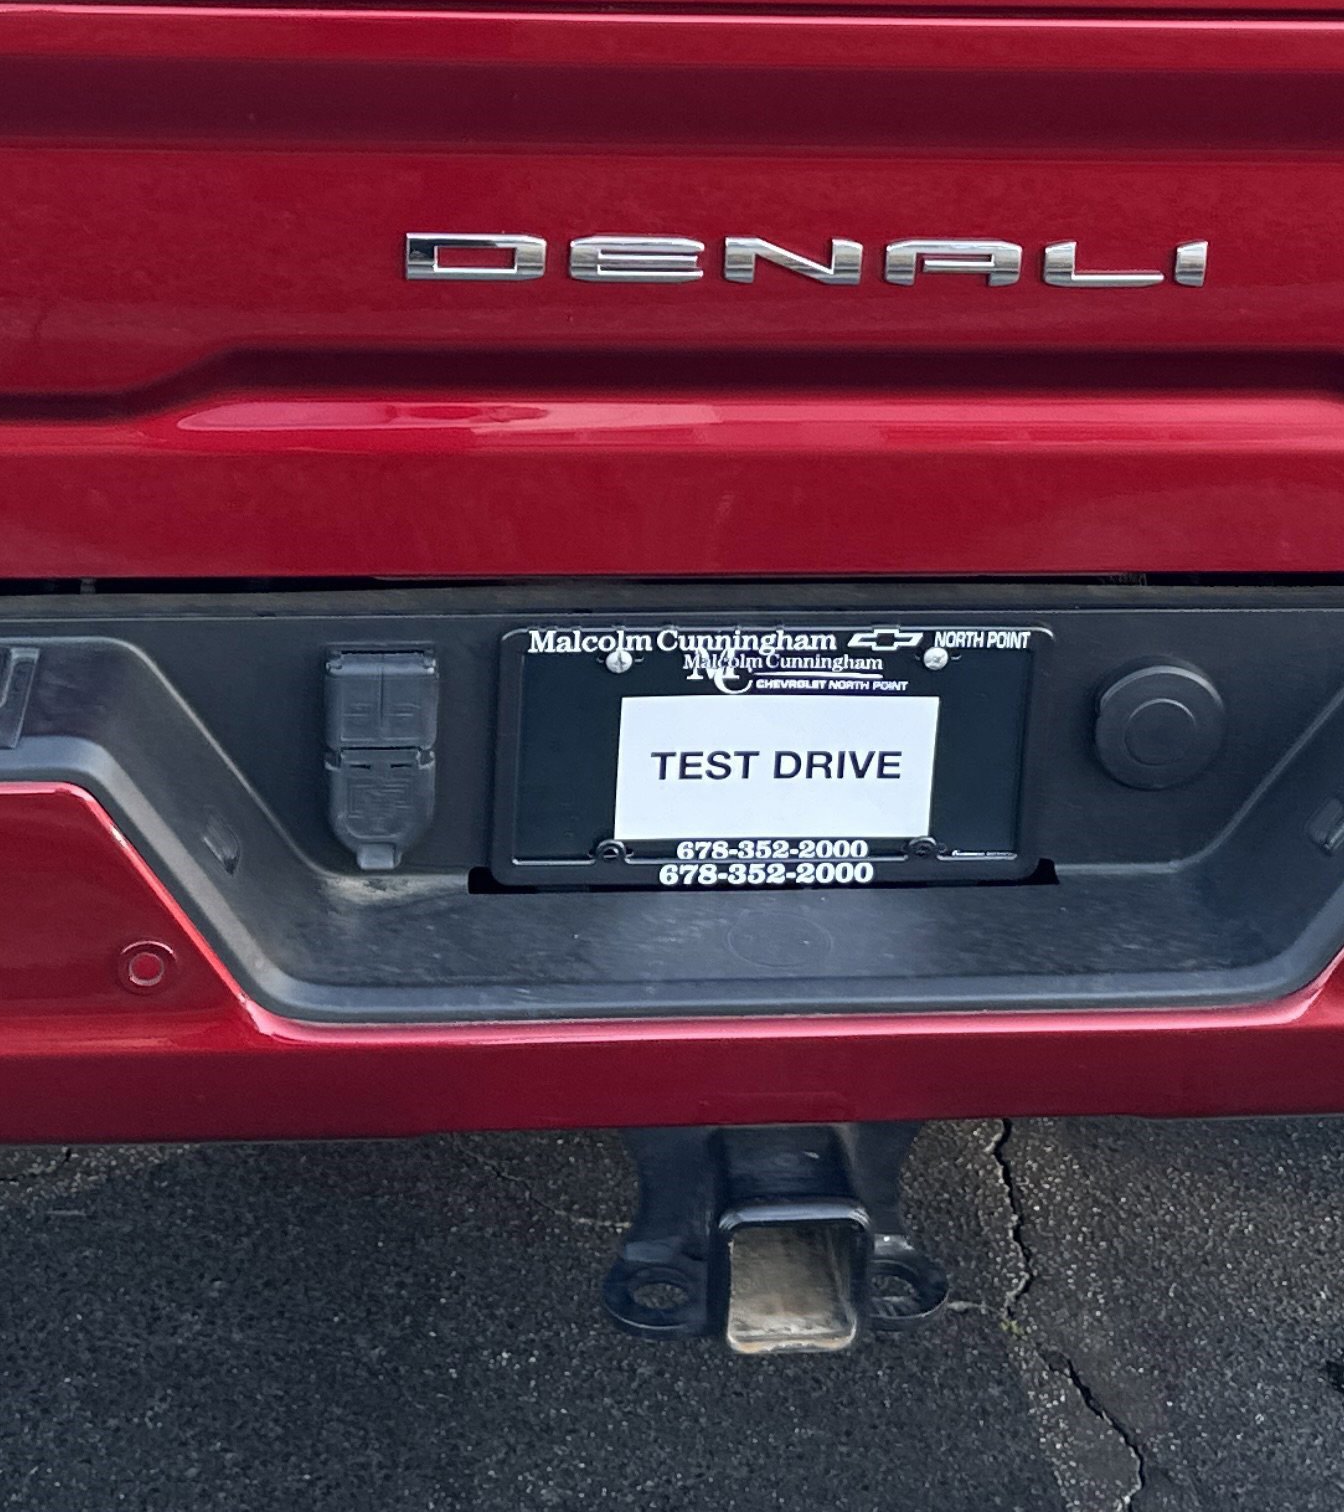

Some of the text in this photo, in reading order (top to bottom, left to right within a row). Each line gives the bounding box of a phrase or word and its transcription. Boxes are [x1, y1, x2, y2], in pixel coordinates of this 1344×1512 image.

[405, 232, 1208, 287] DENALI
[528, 630, 837, 655] Malcolm Cunningham
[934, 631, 1031, 649] NORTH POINT
[683, 653, 883, 672] Malcolm Cunningham
[756, 678, 908, 691] CHEVROLET NORTH POINT
[651, 750, 902, 780] TEST DRIVE
[676, 840, 869, 860] 678-352-2000
[659, 862, 874, 885] 678-352-2000
